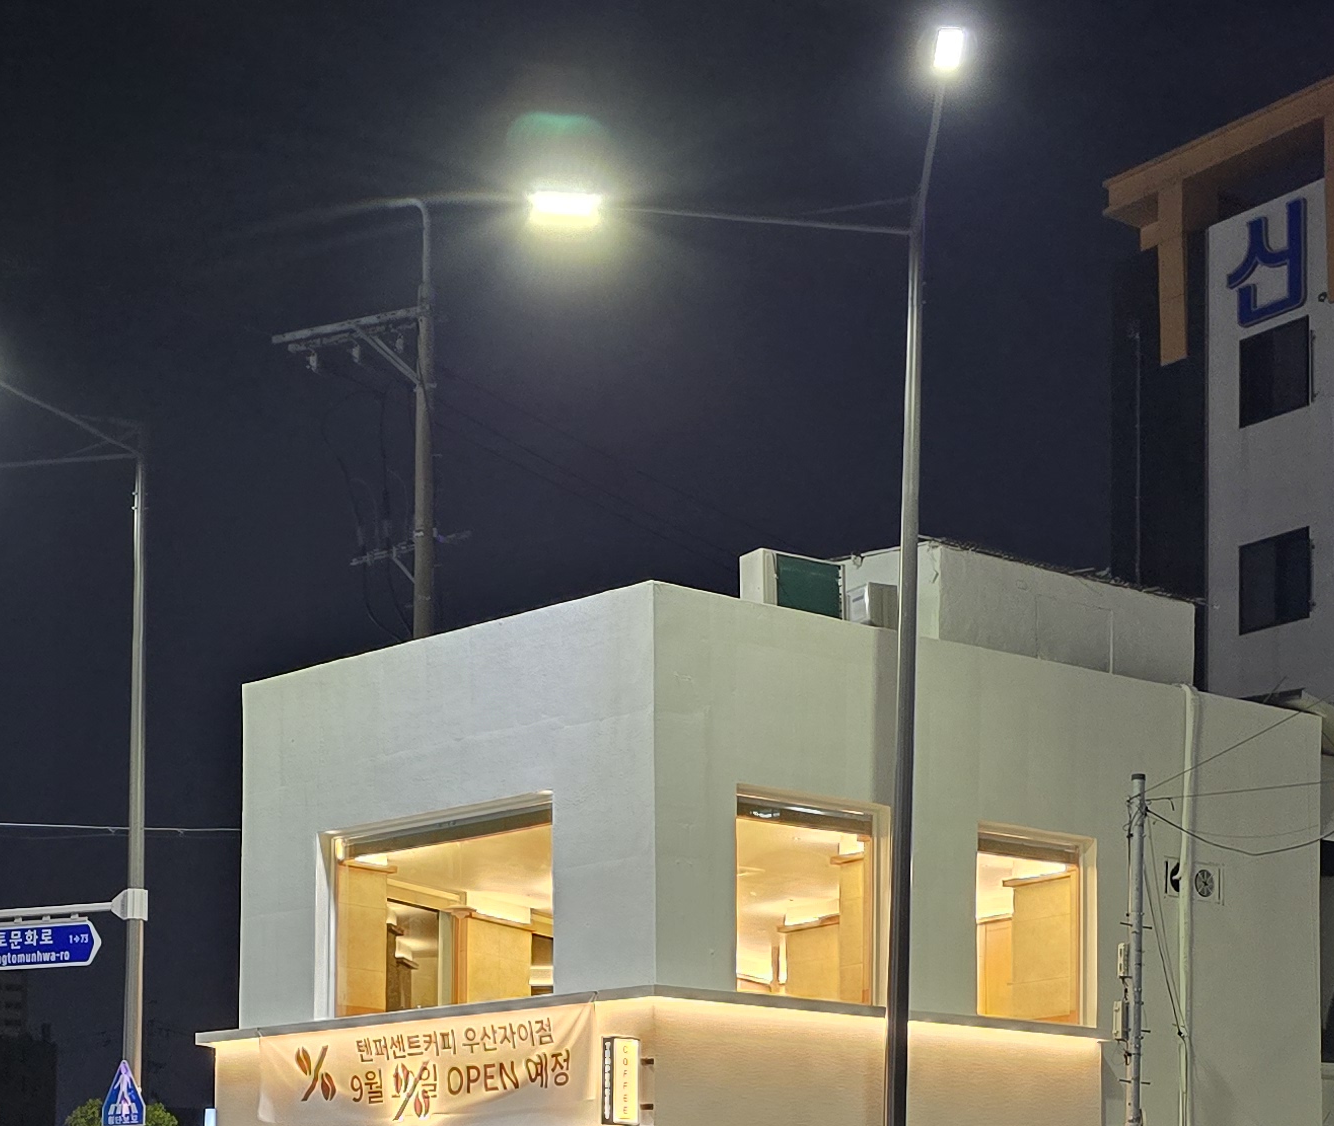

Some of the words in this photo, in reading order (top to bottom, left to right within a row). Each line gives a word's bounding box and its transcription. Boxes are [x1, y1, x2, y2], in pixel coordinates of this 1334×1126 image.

[1226, 198, 1307, 328] 신
[356, 1028, 457, 1062] 텐퍼센트커피
[464, 1018, 555, 1053] 우산자이점
[350, 1067, 384, 1105] 9월
[447, 1059, 520, 1097] OPEN
[526, 1049, 571, 1089] 예정
